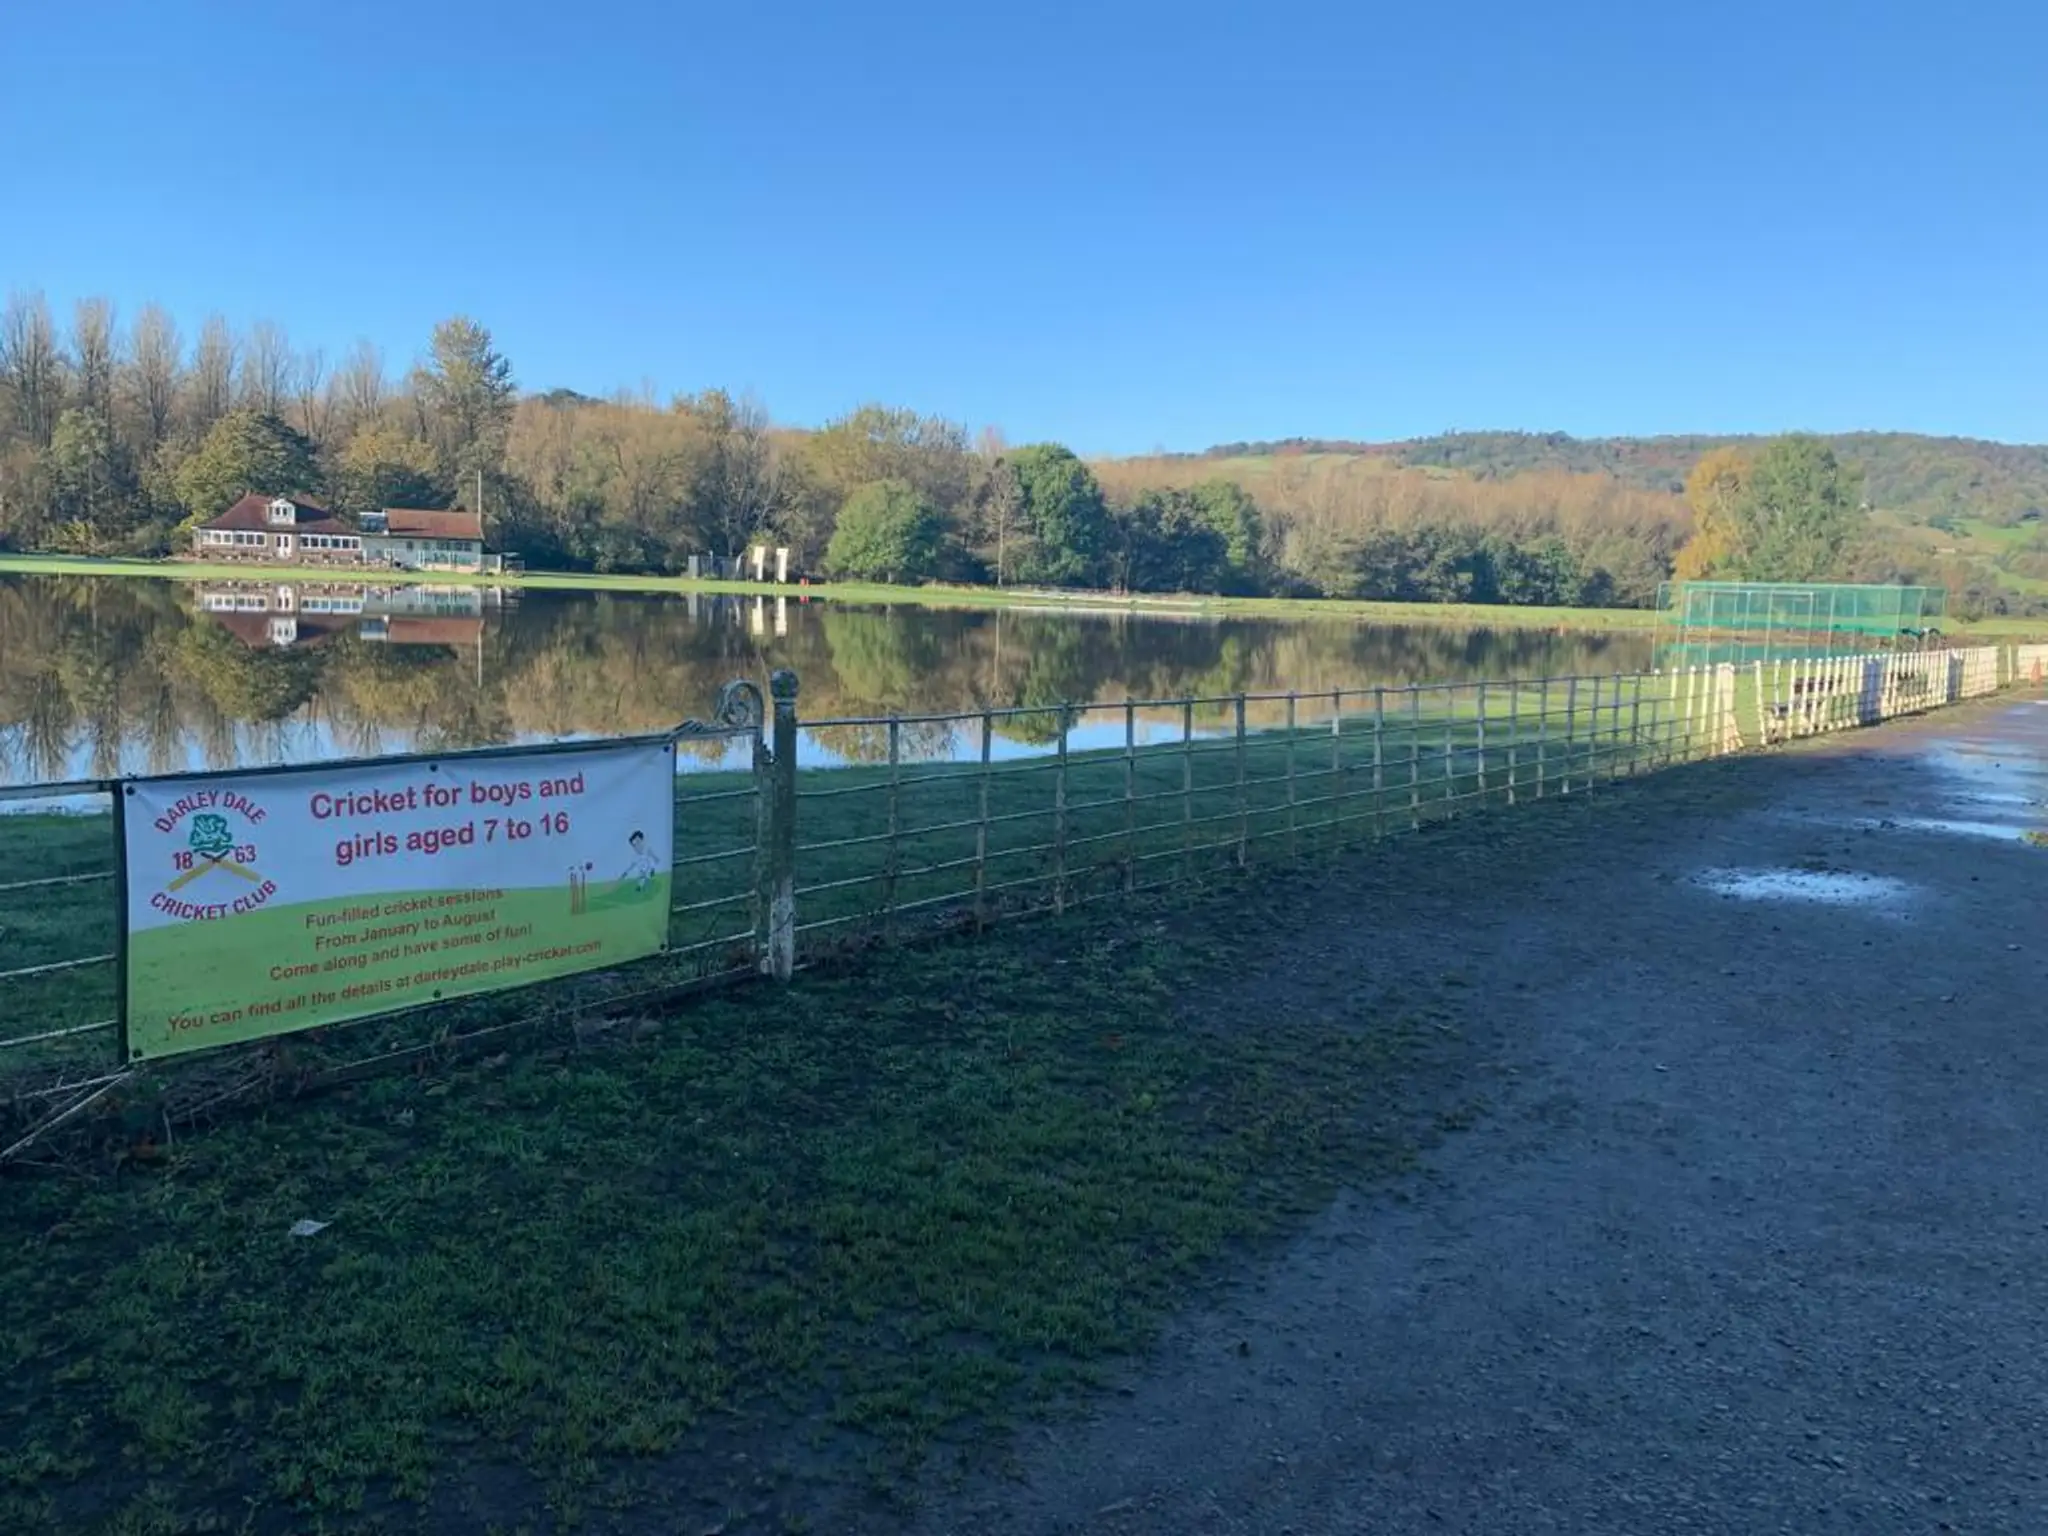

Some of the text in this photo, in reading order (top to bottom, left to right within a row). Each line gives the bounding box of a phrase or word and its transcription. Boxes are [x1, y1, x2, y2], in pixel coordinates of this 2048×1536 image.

[154, 790, 266, 833] DARLEY DALE
[310, 773, 584, 819] Cricket for boys and
[172, 845, 256, 870] 18 63
[336, 811, 569, 866] girls aged 7 to 16
[151, 880, 277, 920] CRICKET CLUB
[306, 888, 504, 929] Fun-filled cricket sessions
[315, 909, 496, 951] From January to August
[270, 923, 533, 981] Come along and have some of fun!
[168, 940, 601, 1032] You can find all the details at darleydale.play-cricket.com
